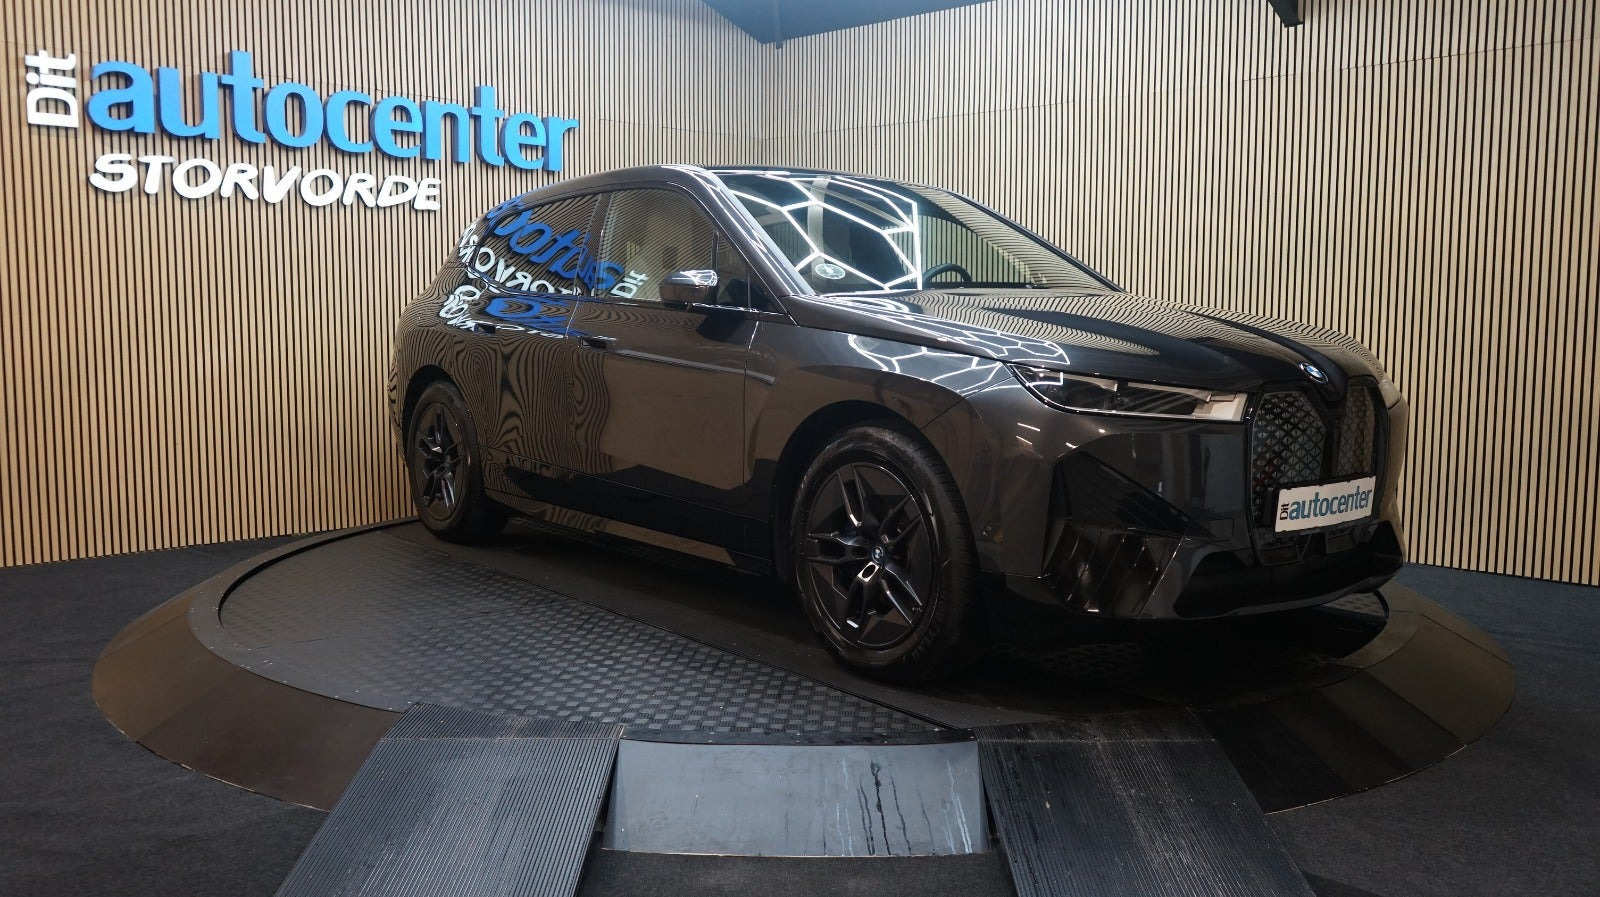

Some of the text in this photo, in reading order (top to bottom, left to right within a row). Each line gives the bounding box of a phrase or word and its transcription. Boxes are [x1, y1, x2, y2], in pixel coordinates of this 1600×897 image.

[25, 50, 579, 172] Dit autocenter
[89, 153, 442, 212] STORVORDE
[1279, 487, 1373, 520] Dit autocenter
